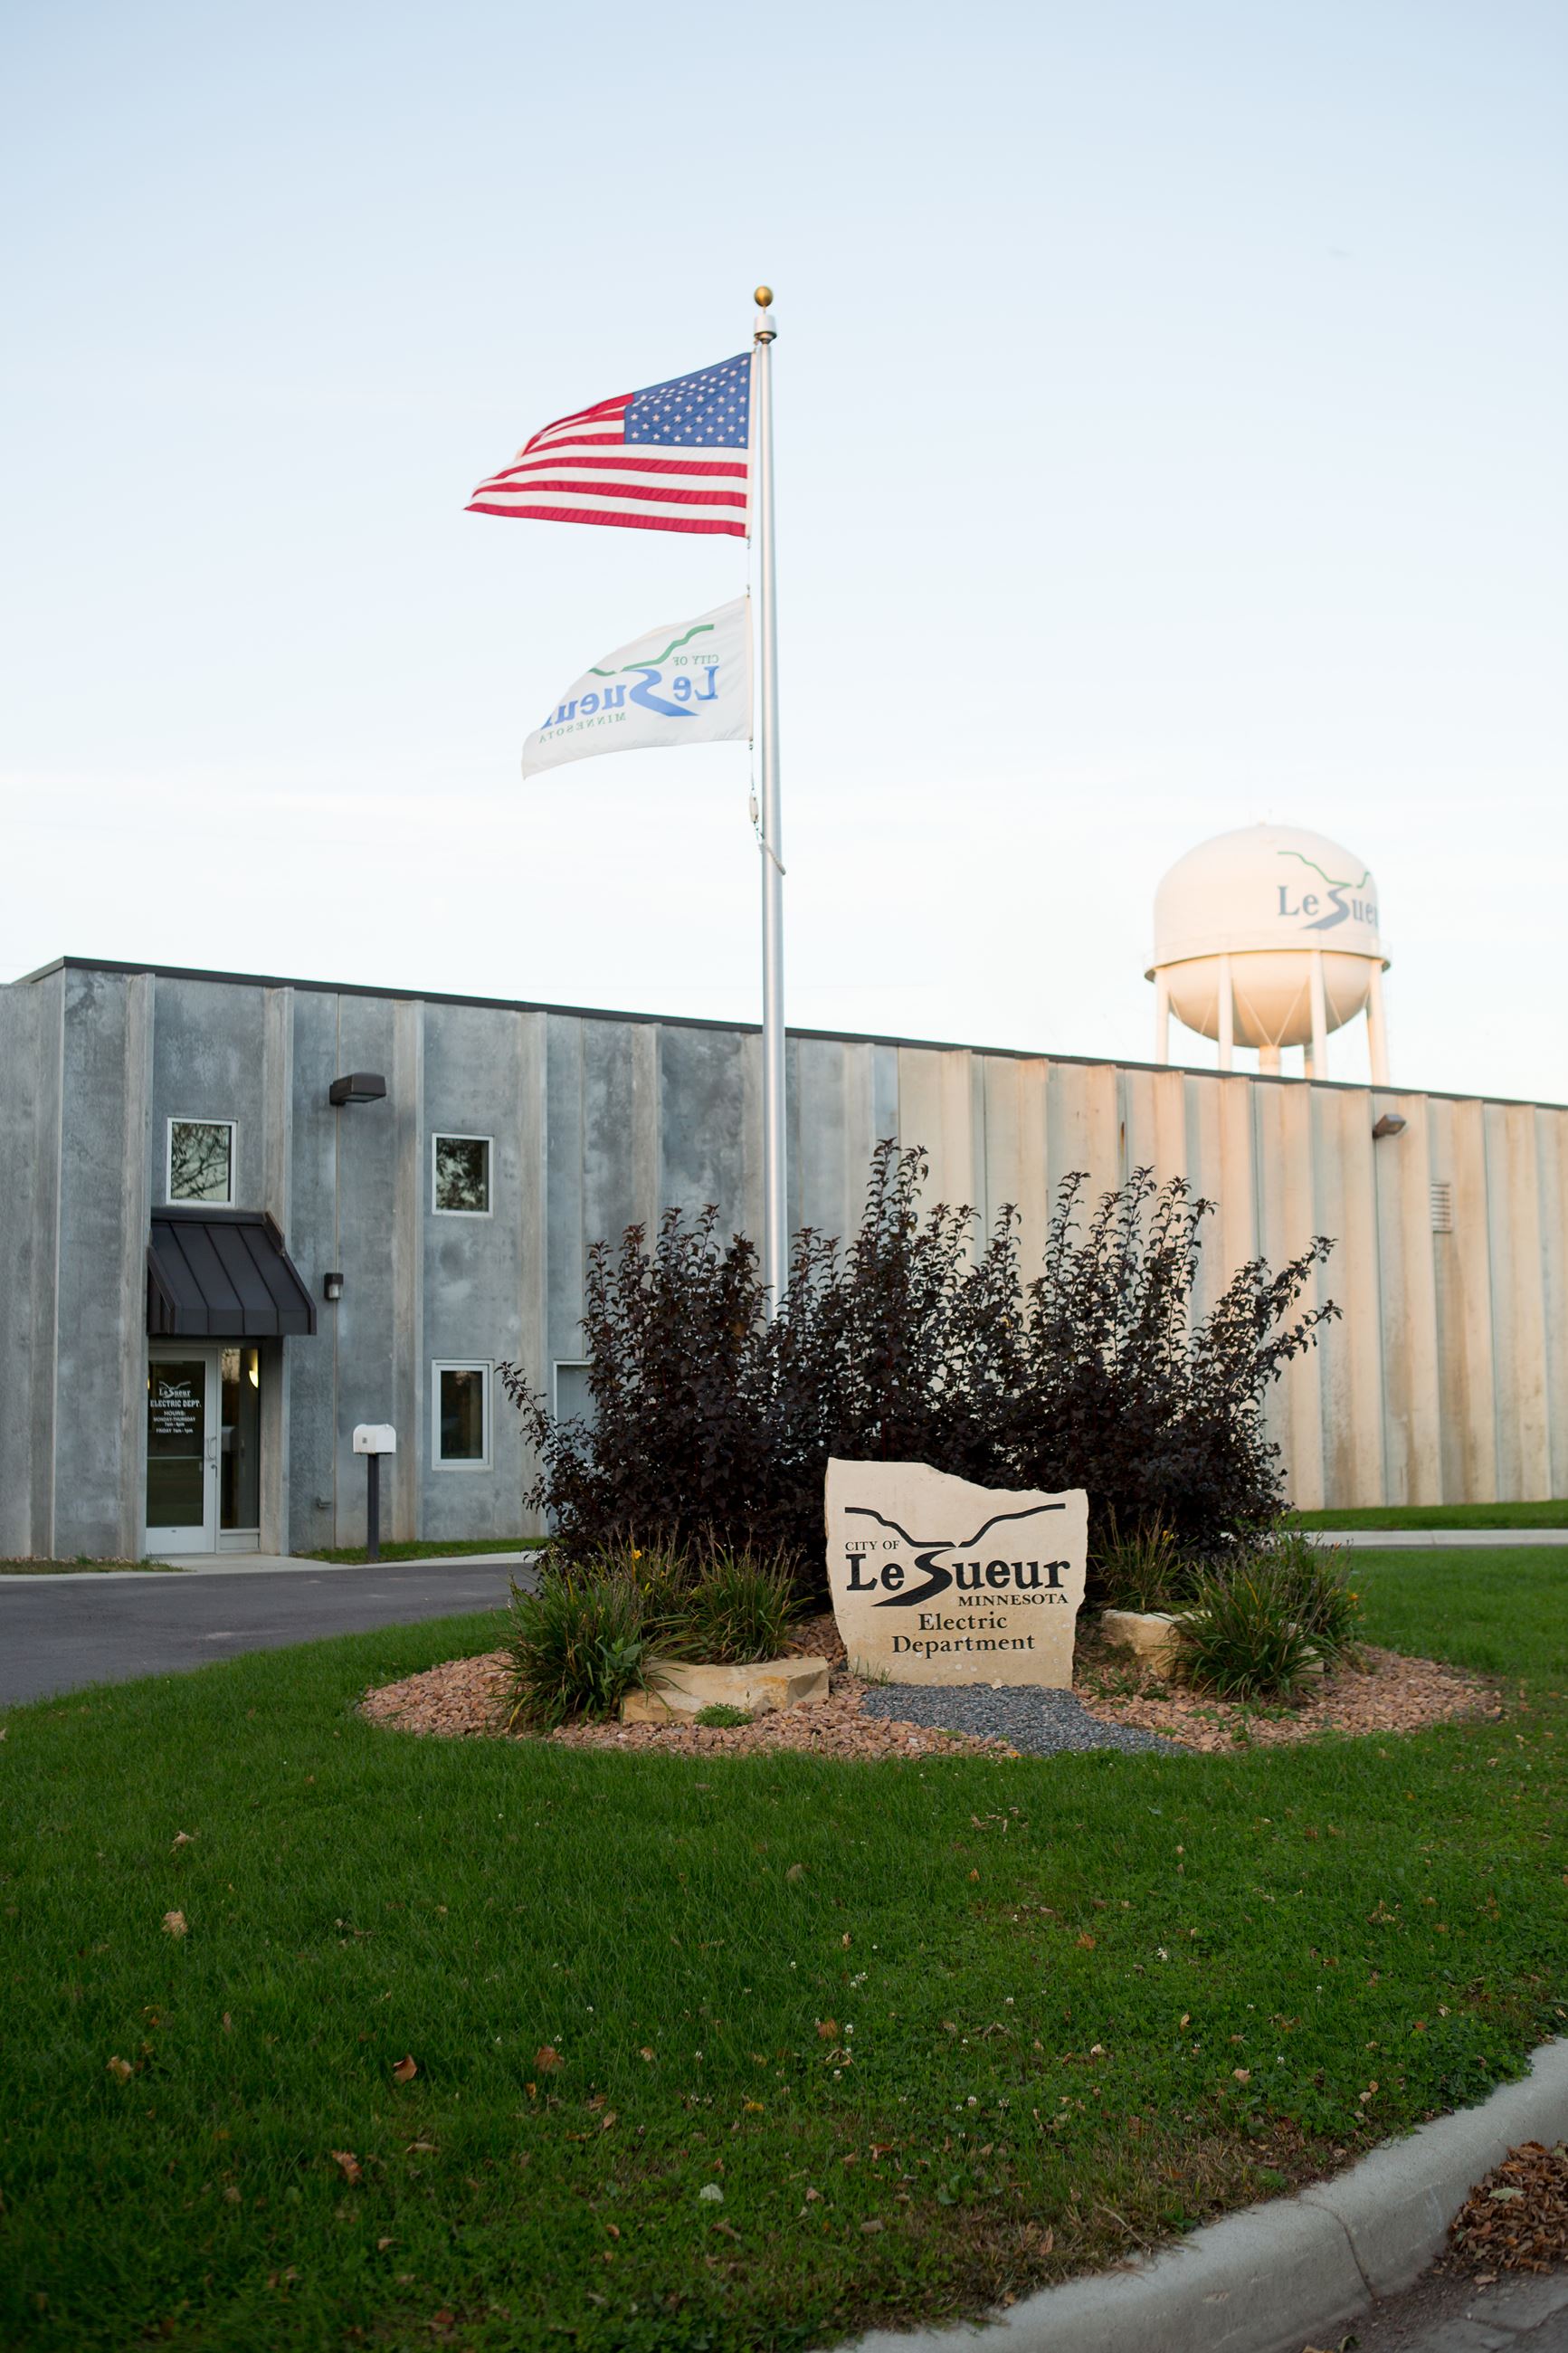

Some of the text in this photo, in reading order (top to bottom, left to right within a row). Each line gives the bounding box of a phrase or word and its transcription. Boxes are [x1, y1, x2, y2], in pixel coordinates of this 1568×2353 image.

[150, 1399, 202, 1408] ELECTRIC DEPT.
[844, 1540, 900, 1551] CITY OF
[957, 1593, 1069, 1607] MINNESOTA
[917, 1611, 1008, 1631] Electric
[891, 1634, 1036, 1660] Department
